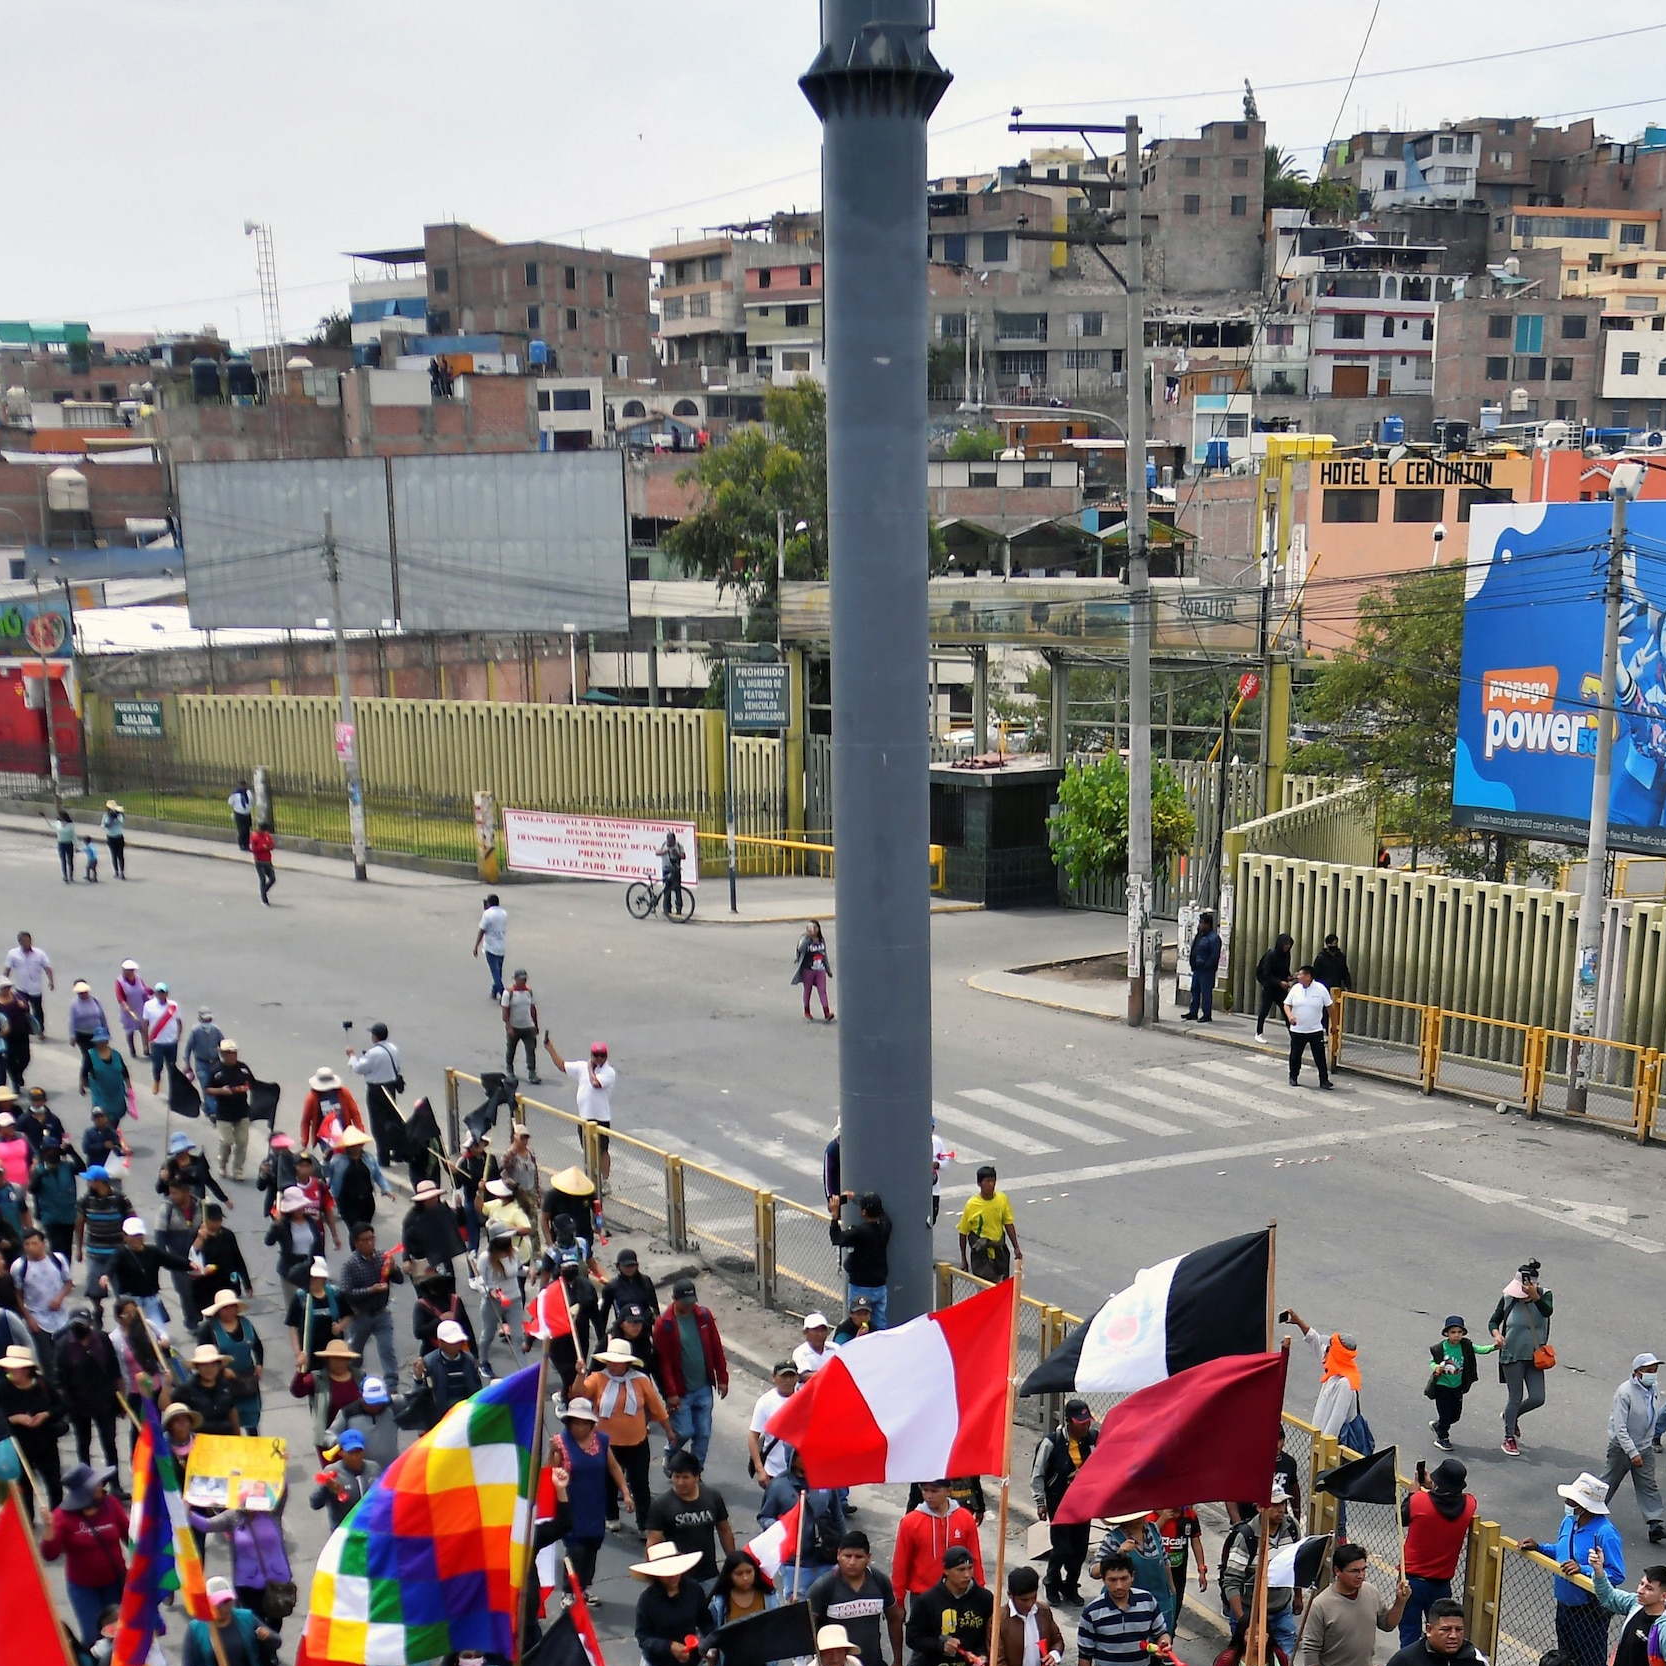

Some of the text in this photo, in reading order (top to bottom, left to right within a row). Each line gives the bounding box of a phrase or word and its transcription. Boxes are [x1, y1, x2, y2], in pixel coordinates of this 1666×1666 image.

[1320, 462, 1493, 485] HOTEL EL CENTURION
[735, 667, 785, 677] PROHIBIDO
[737, 679, 746, 688] EL
[773, 679, 782, 688] DE
[1241, 673, 1259, 698] PARE
[743, 690, 774, 700] PEATONES
[1489, 679, 1550, 705] prepago
[140, 702, 159, 713] SOLO
[121, 713, 154, 726] SALIDA
[734, 711, 785, 721] NO AUTORIZADOS
[1485, 710, 1587, 758] power
[592, 822, 641, 831] TRANSPORTE
[1489, 813, 1505, 825] hasta
[1532, 821, 1543, 831] con
[1555, 821, 1570, 834] Entel
[517, 834, 561, 844] TRANSPORTE
[564, 838, 628, 850] INTERPROVINCIAL
[595, 831, 631, 840] AREQUIPA
[578, 849, 623, 860] PRESENTE
[547, 857, 567, 868] VIVA
[568, 860, 579, 869] EL
[582, 862, 606, 871] PARO
[675, 1510, 714, 1527] SOMA
